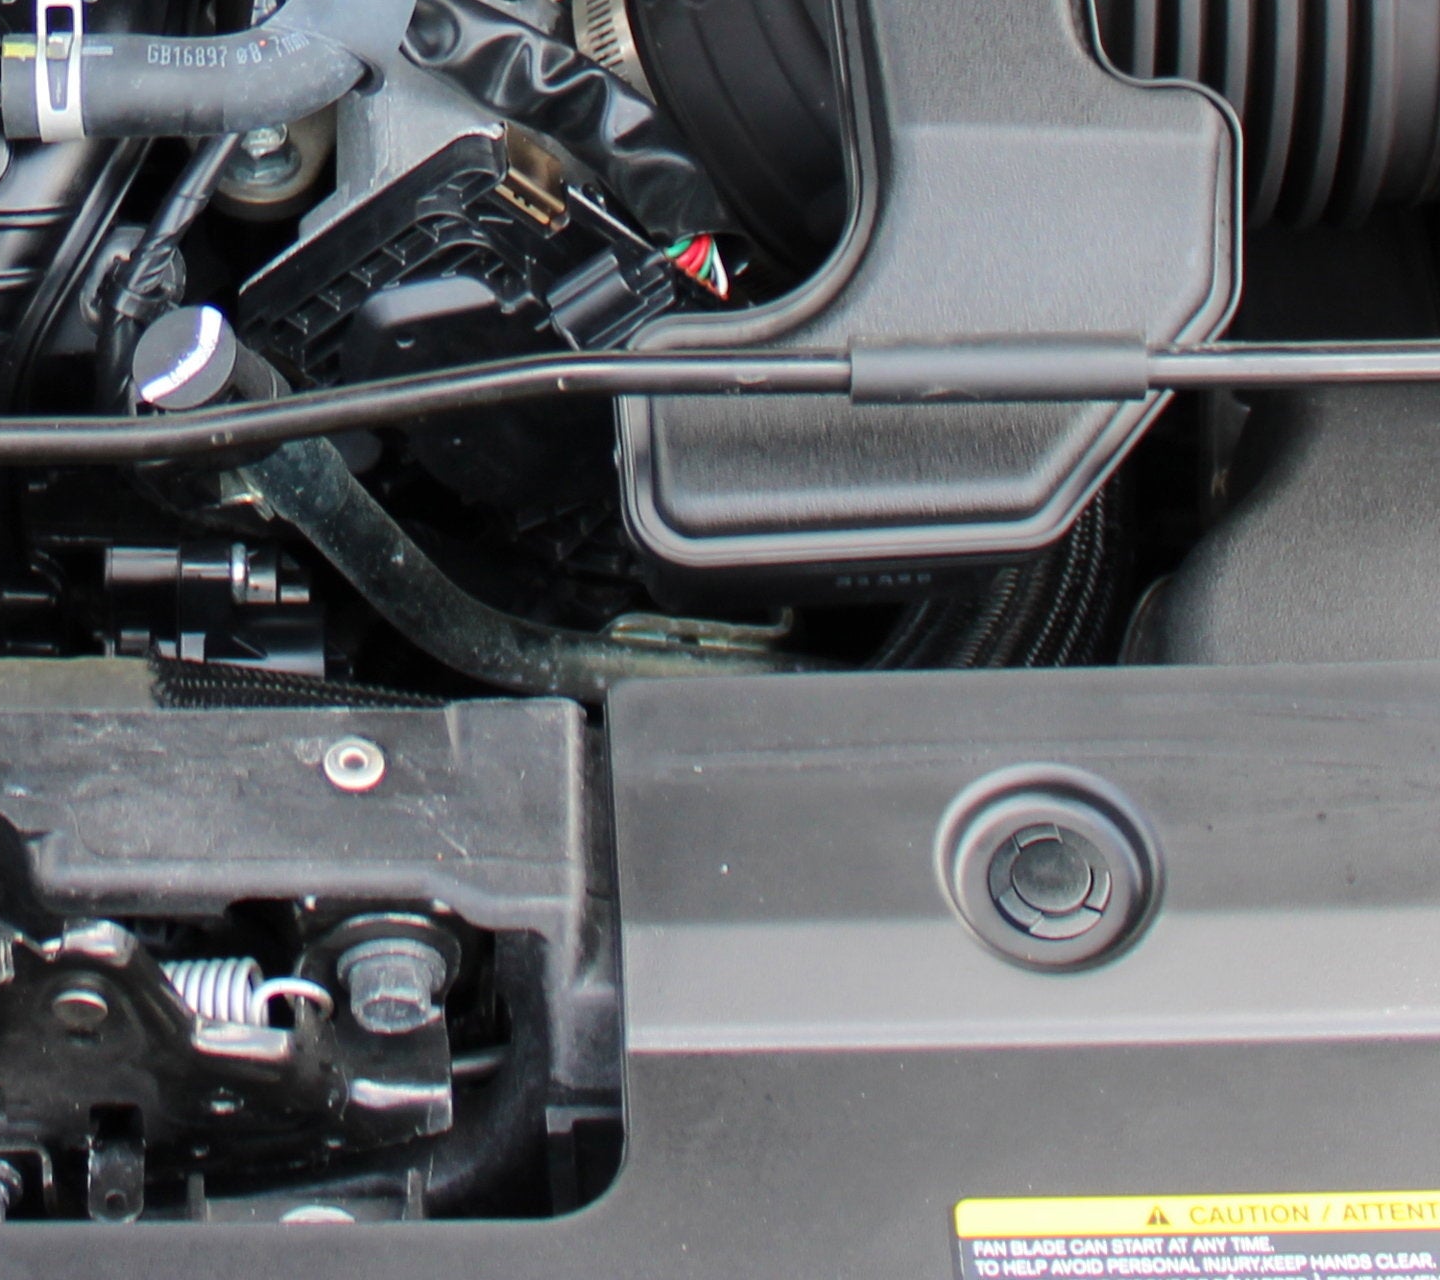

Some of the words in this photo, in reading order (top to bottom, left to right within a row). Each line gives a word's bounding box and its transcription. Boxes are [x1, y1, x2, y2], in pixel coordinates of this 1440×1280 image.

[1190, 1204, 1309, 1225] CAUTION
[973, 1240, 1007, 1257] FAN
[1010, 1239, 1068, 1256] BLADE
[1071, 1239, 1108, 1256] CAN
[1112, 1238, 1164, 1255] START
[1168, 1237, 1189, 1254] AT
[1192, 1236, 1228, 1254] ANY
[1230, 1236, 1275, 1252] TIME.
[974, 1259, 1000, 1277] TO
[1002, 1258, 1049, 1276] HELP
[1051, 1258, 1104, 1275] AVOID
[1107, 1256, 1201, 1275] PERSONAL
[1310, 1253, 1373, 1271] HANDS
[1375, 1252, 1437, 1270] CLEAR.
